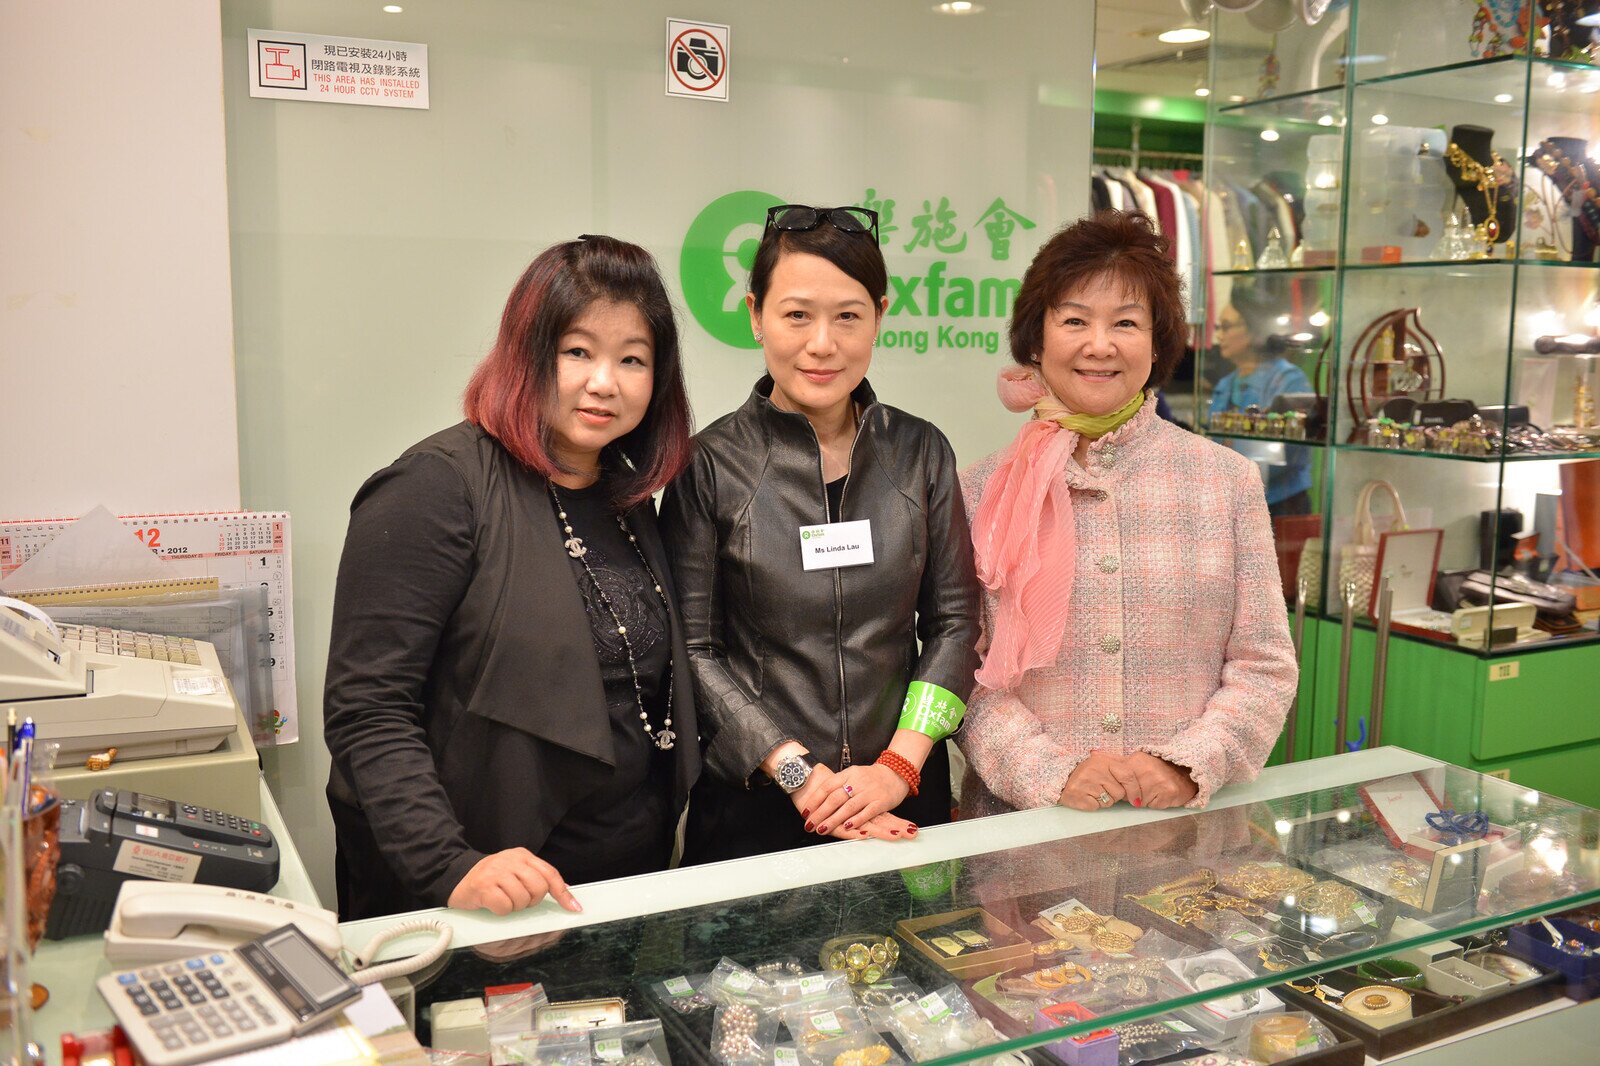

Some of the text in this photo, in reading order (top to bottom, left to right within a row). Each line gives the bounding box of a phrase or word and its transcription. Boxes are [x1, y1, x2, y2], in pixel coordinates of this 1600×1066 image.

[324, 45, 407, 61] 現已安裝24小時
[312, 59, 420, 78] 閉路電視及錄影系統
[313, 73, 420, 89] THIS AREA HAS INSTALLED
[320, 84, 414, 98] 24 HOUR CCTV SYSTEM
[887, 261, 1022, 318] xfam
[937, 325, 999, 354] Kong
[260, 556, 266, 566] 1
